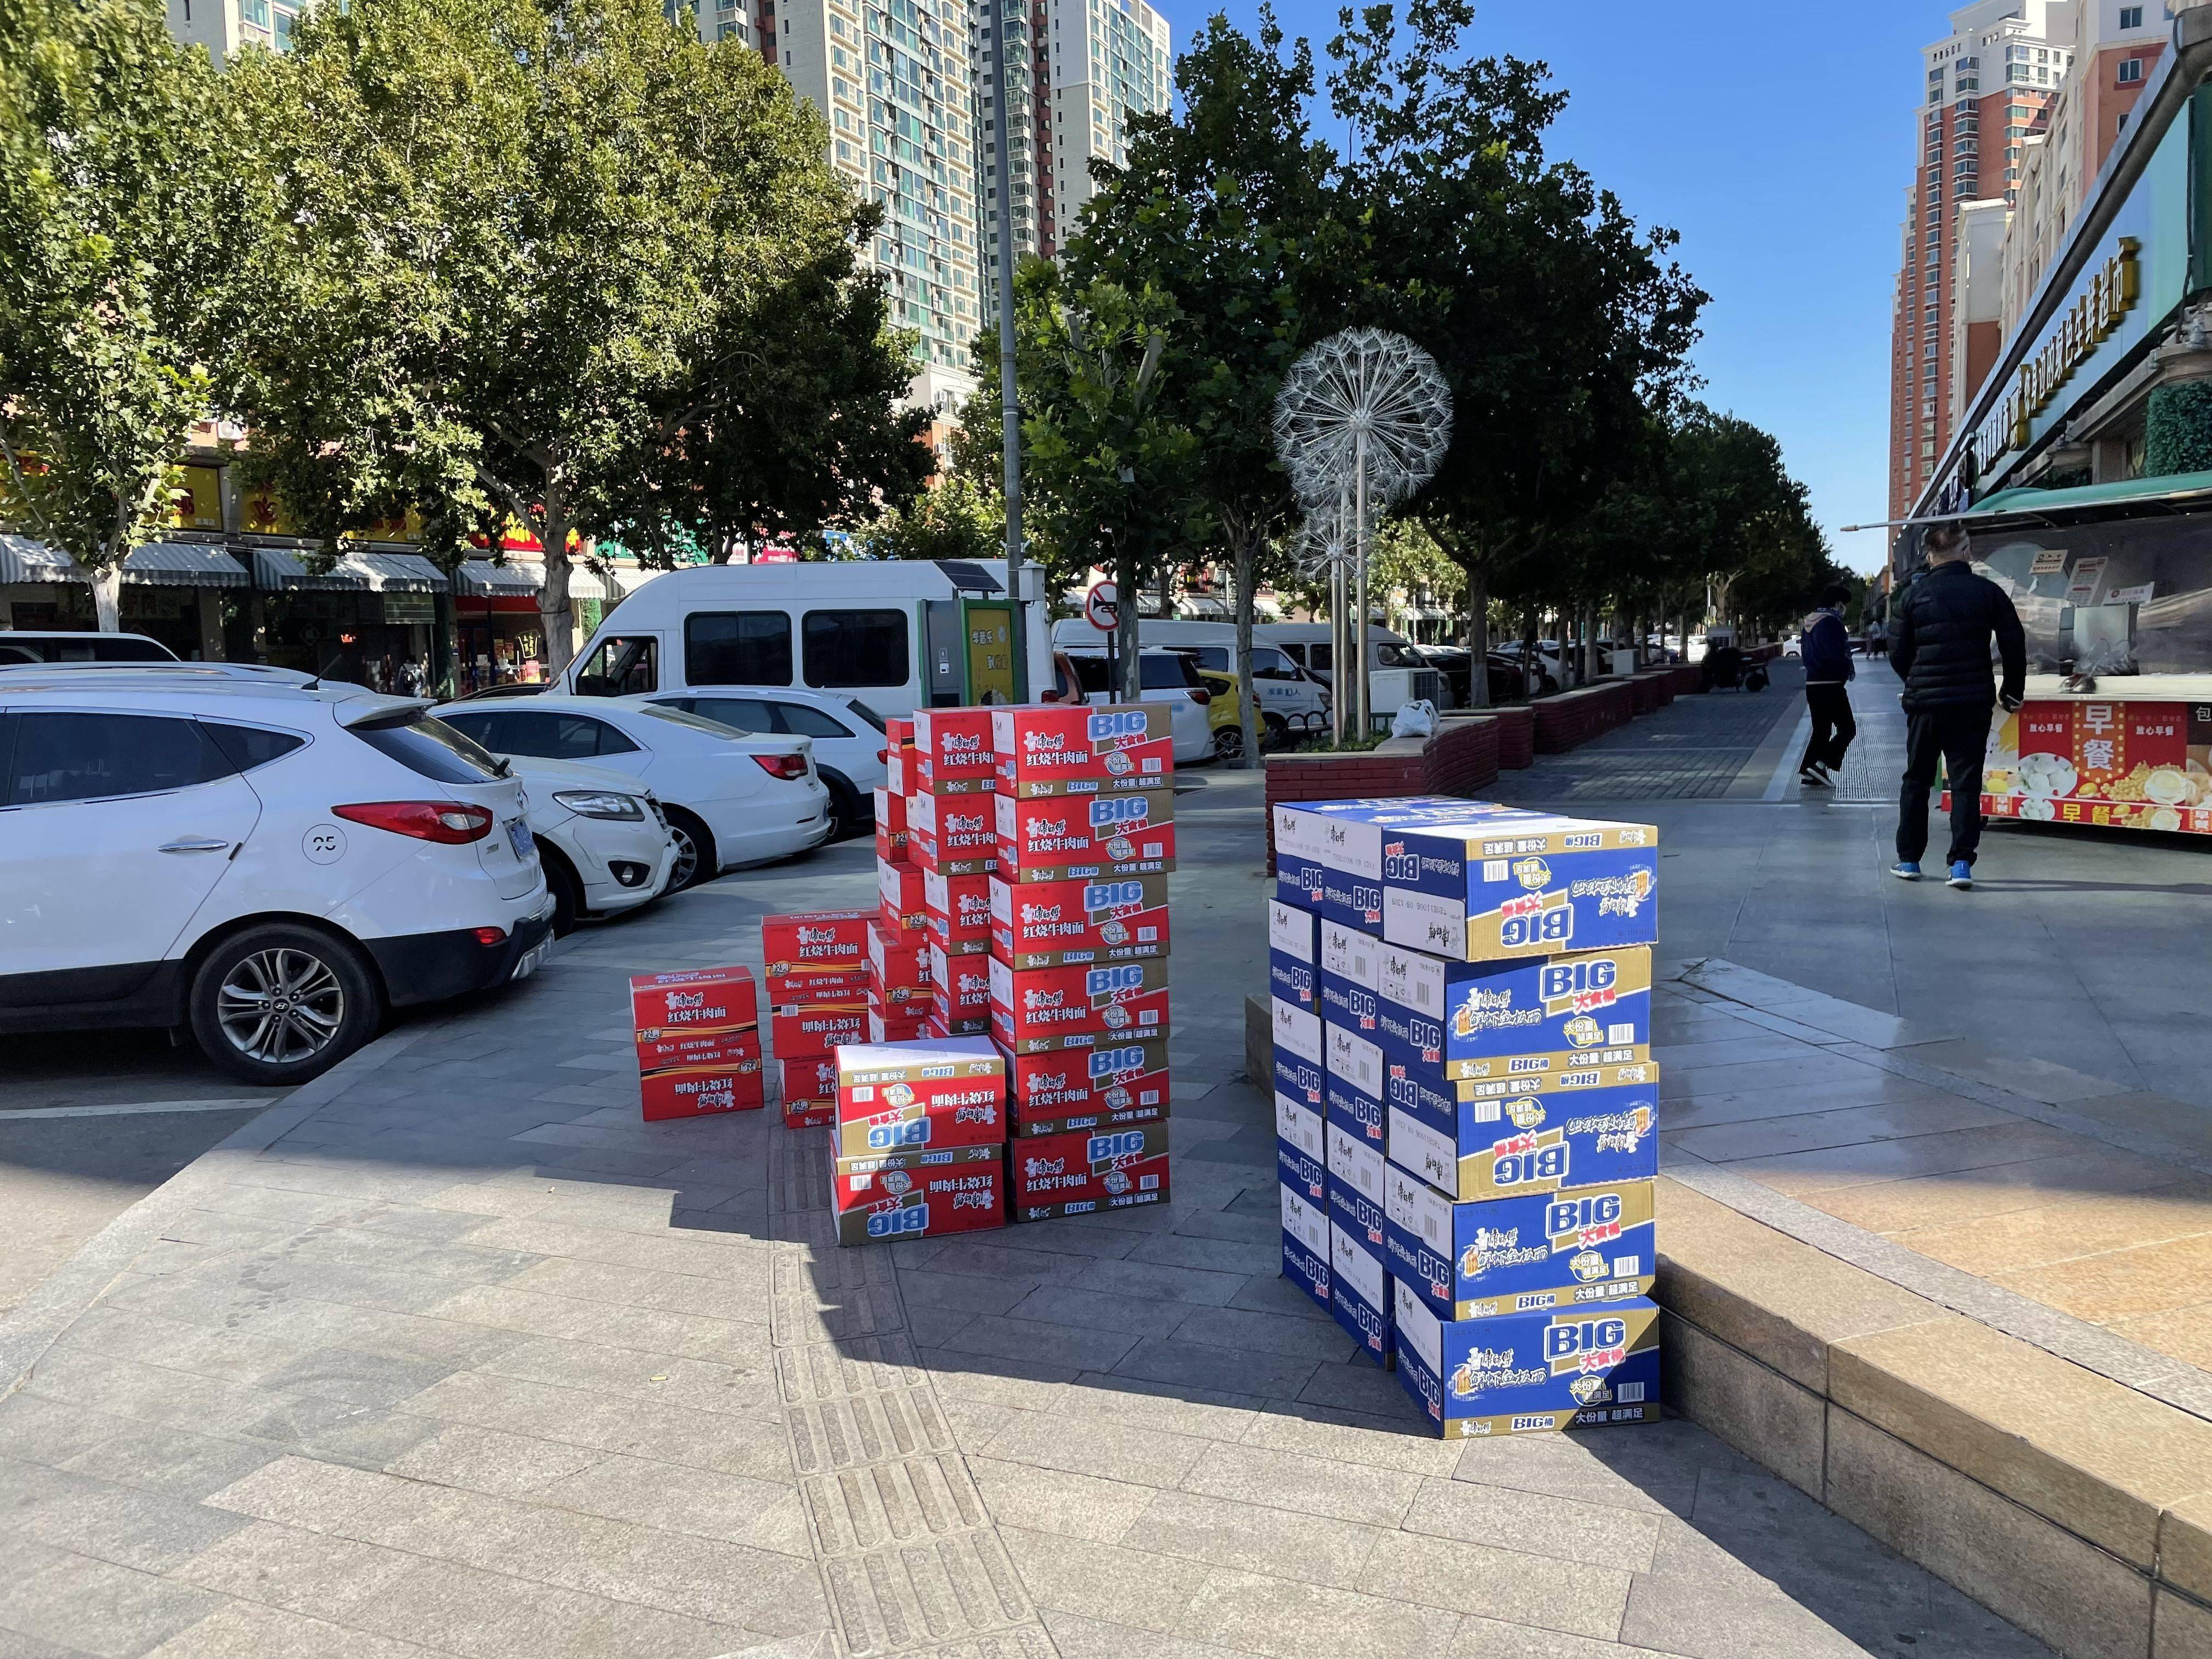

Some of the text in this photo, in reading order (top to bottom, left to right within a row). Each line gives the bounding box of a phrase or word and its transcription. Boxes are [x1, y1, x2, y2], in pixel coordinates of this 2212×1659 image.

[2196, 707, 2211, 722] 包
[1088, 712, 1147, 741] BIG
[2083, 705, 2114, 770] 早餐
[944, 752, 995, 765] 红烧牛肉
[1026, 751, 1088, 766] 红烧牛肉面
[1090, 797, 1148, 826] BIG
[947, 833, 996, 847] 红烧牛肉
[1028, 836, 1089, 852] 红烧牛肉面
[1484, 839, 1547, 855] 大份量 超满足
[1386, 854, 1419, 880] BIG
[1085, 882, 1143, 912] BIG
[1353, 885, 1381, 911] BIG
[910, 915, 927, 925] 经典
[1023, 921, 1084, 938] 红烧牛肉面
[1501, 904, 1573, 947] BIG
[799, 943, 858, 957] 红烧牛肉面
[1087, 965, 1144, 996] BIG
[1291, 967, 1312, 990] BIG
[1540, 960, 1616, 1001] BIG
[892, 989, 910, 999] 经典
[1350, 989, 1375, 1016] BIG
[668, 1007, 726, 1023] 红烧牛肉面
[802, 1018, 860, 1033] 红烧牛肉面
[1026, 1007, 1086, 1024] 红烧牛肉面
[643, 1029, 660, 1038] 经典
[1410, 1018, 1441, 1048] BIG
[1565, 1021, 1596, 1032] 大份量
[1089, 1046, 1144, 1079] BIG
[1509, 1058, 1549, 1072] BIG桶
[1569, 1049, 1633, 1066] 大份量 超满足
[675, 1079, 732, 1094] 红烧牛肉面
[1297, 1065, 1321, 1092] BIG
[1475, 1079, 1541, 1096] 大份量 超满足
[932, 1091, 994, 1107] 红烧牛肉面
[1029, 1088, 1088, 1107] 红烧牛肉面
[1390, 1076, 1418, 1108] BIG
[791, 1101, 809, 1111] 经典
[1355, 1097, 1381, 1127] BIG
[868, 1117, 930, 1149] BIG
[1088, 1131, 1144, 1163] BIG
[1300, 1157, 1322, 1187] BIG
[1493, 1141, 1569, 1186] BIG
[930, 1176, 992, 1193] 红烧牛肉面
[1026, 1173, 1087, 1192] 红烧牛肉面
[867, 1204, 928, 1237] BIG
[1357, 1198, 1382, 1233] BIG
[1546, 1193, 1621, 1239] BIG
[1306, 1255, 1329, 1288] BIG
[1418, 1249, 1449, 1286] BIG
[1571, 1255, 1600, 1268] 大份量
[1575, 1282, 1638, 1300] 大份量 超满足
[1516, 1294, 1556, 1310] BIG桶
[1358, 1303, 1382, 1339] BIG
[1544, 1318, 1626, 1362] BIG
[1581, 1348, 1626, 1373] 大食桶
[1419, 1365, 1440, 1406] BIG
[1470, 1368, 1546, 1389] 鲜虾鱼板面
[1511, 1417, 1554, 1430] BIG桶
[1576, 1408, 1643, 1425] 大份量 超满足
